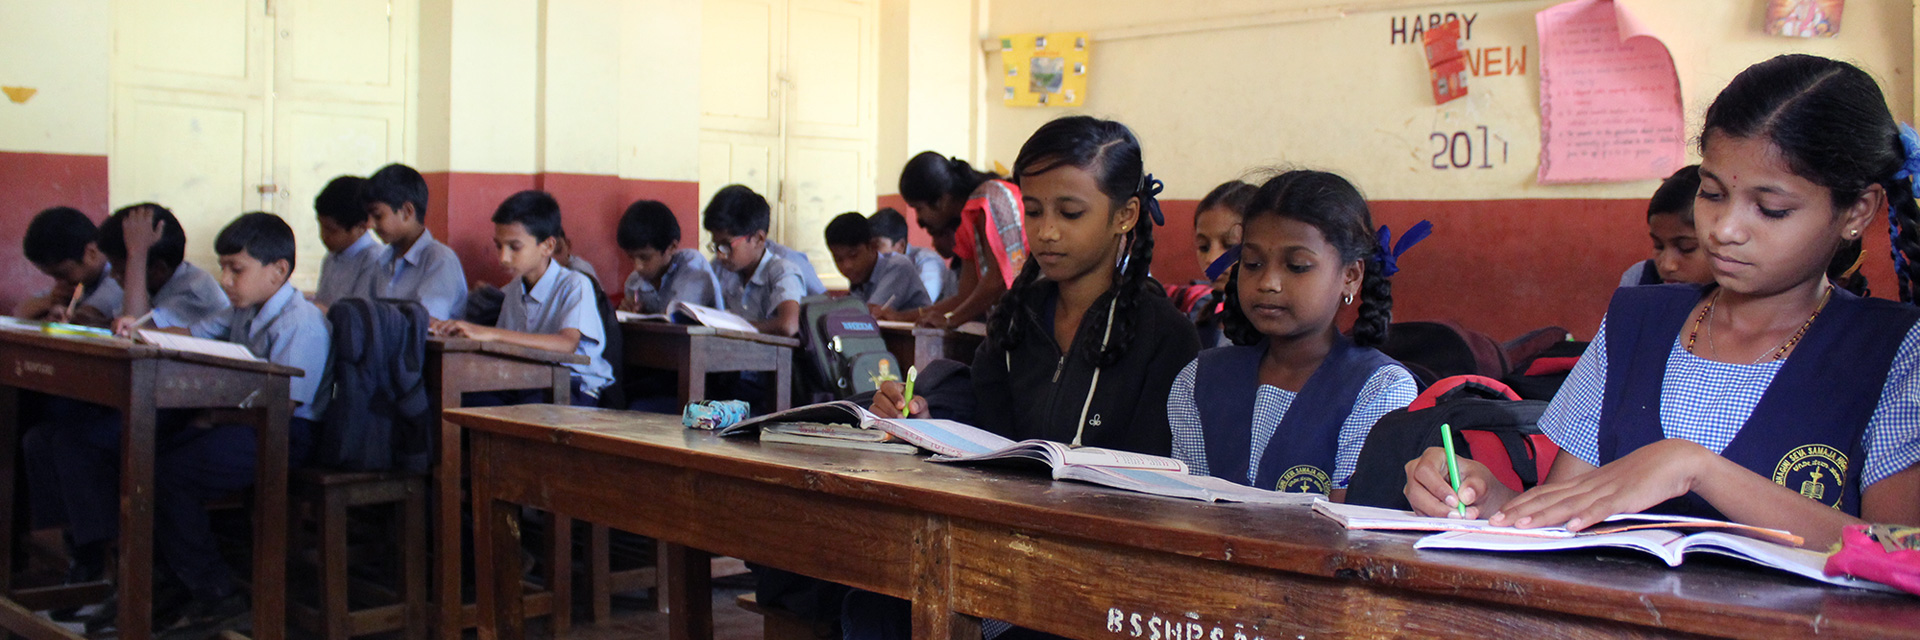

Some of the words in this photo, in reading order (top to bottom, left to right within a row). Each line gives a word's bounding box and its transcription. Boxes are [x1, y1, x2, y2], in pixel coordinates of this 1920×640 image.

[1465, 45, 1527, 77] NEW
[1789, 448, 1807, 461] SEVA
[1807, 446, 1837, 460] SAMAJA
